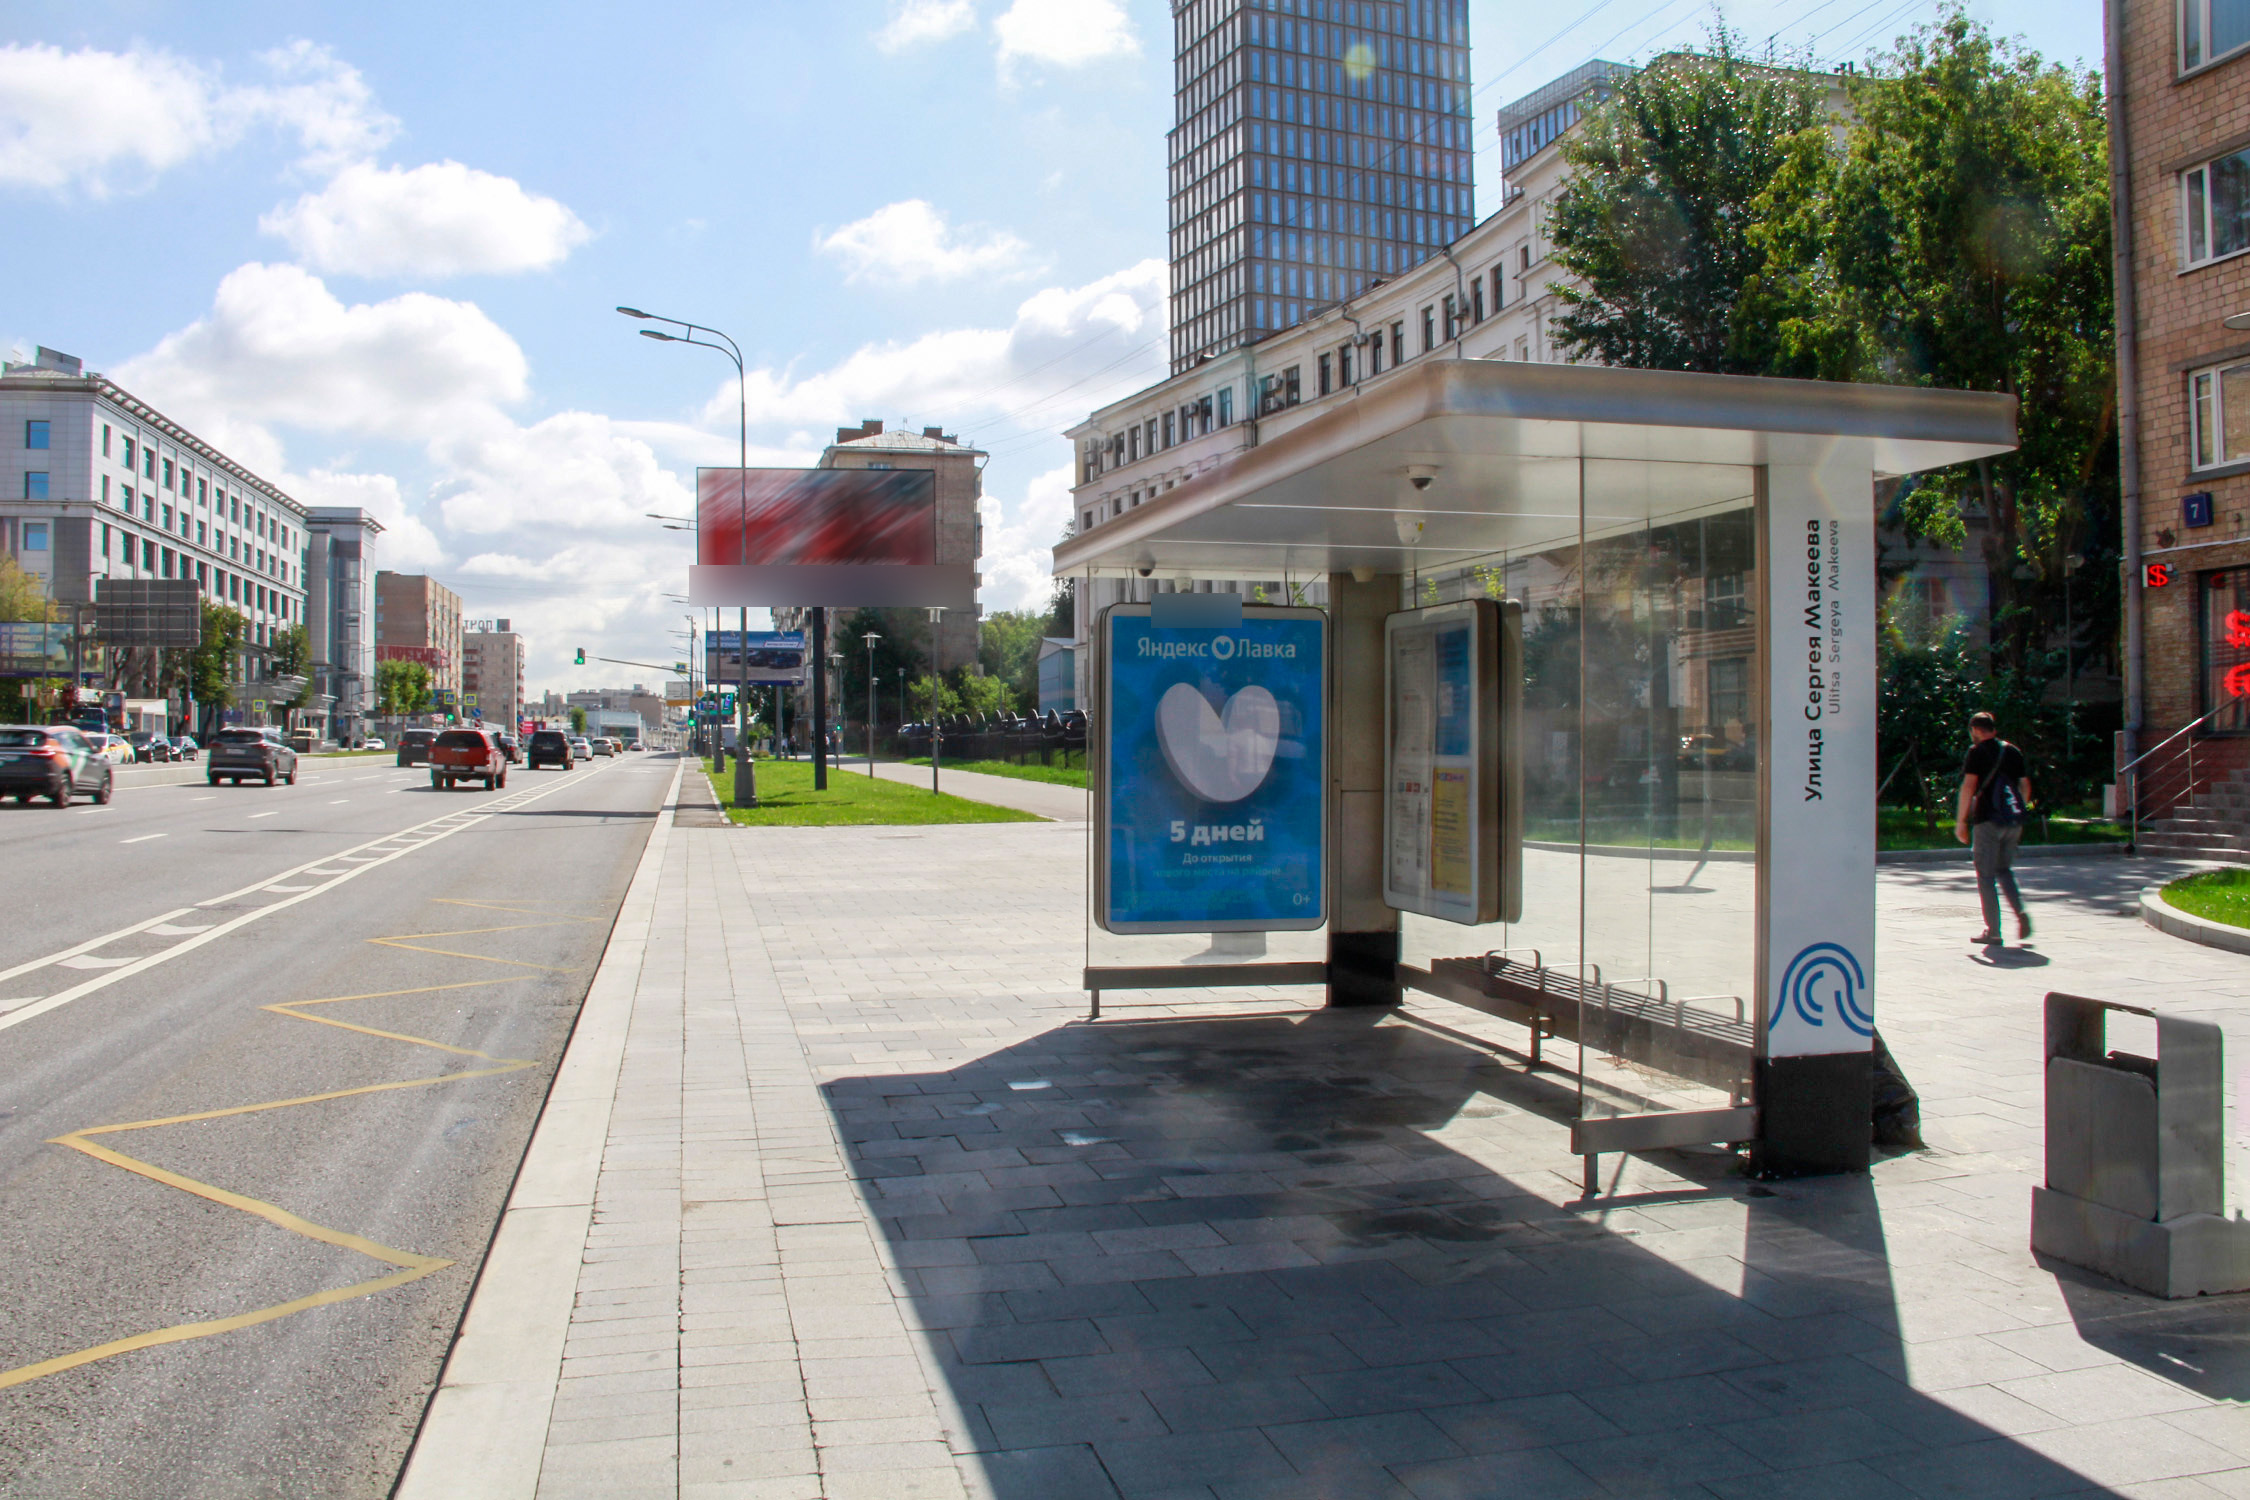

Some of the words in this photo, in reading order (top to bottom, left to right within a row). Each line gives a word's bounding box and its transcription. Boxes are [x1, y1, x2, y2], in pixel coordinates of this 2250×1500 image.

[2190, 503, 2199, 519] 7
[1804, 519, 1821, 630] Макеева
[1827, 519, 1840, 591] Makeeva
[1137, 636, 1208, 660] Яндекс
[1236, 638, 1297, 659] Лавка
[1828, 600, 1843, 663] Sergeya
[1804, 636, 1825, 721] Сергея
[1828, 671, 1841, 714] Ulitsa
[1804, 728, 1824, 802] Улица
[1170, 820, 1186, 842] 5
[1190, 818, 1265, 846] дней
[1182, 853, 1199, 865] До
[1200, 853, 1253, 865] открытия
[1293, 892, 1311, 906] 0+
